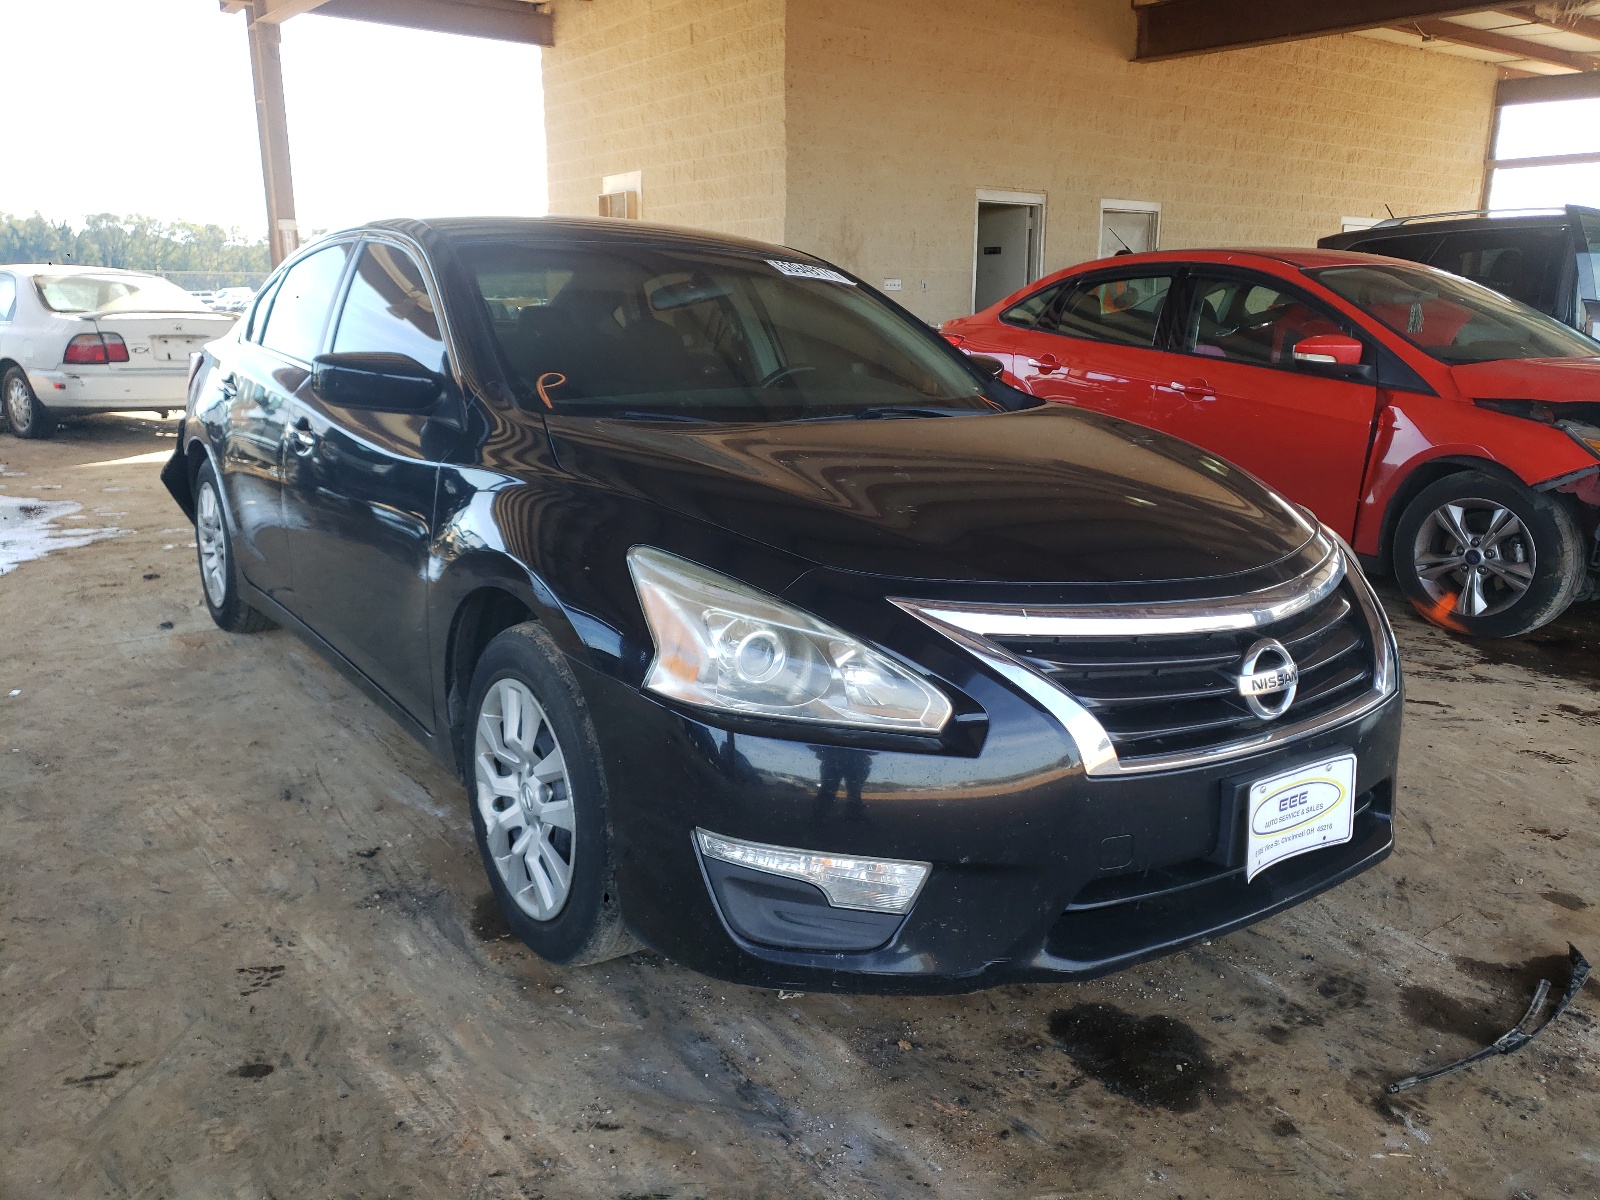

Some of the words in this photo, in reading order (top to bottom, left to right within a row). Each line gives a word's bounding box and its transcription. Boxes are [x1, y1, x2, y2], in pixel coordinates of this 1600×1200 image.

[1251, 671, 1298, 691] NISSAN
[1278, 790, 1309, 812] EEE
[1264, 816, 1278, 829] AUTO
[1278, 809, 1301, 824] SERVICE
[1305, 803, 1324, 814] SALES
